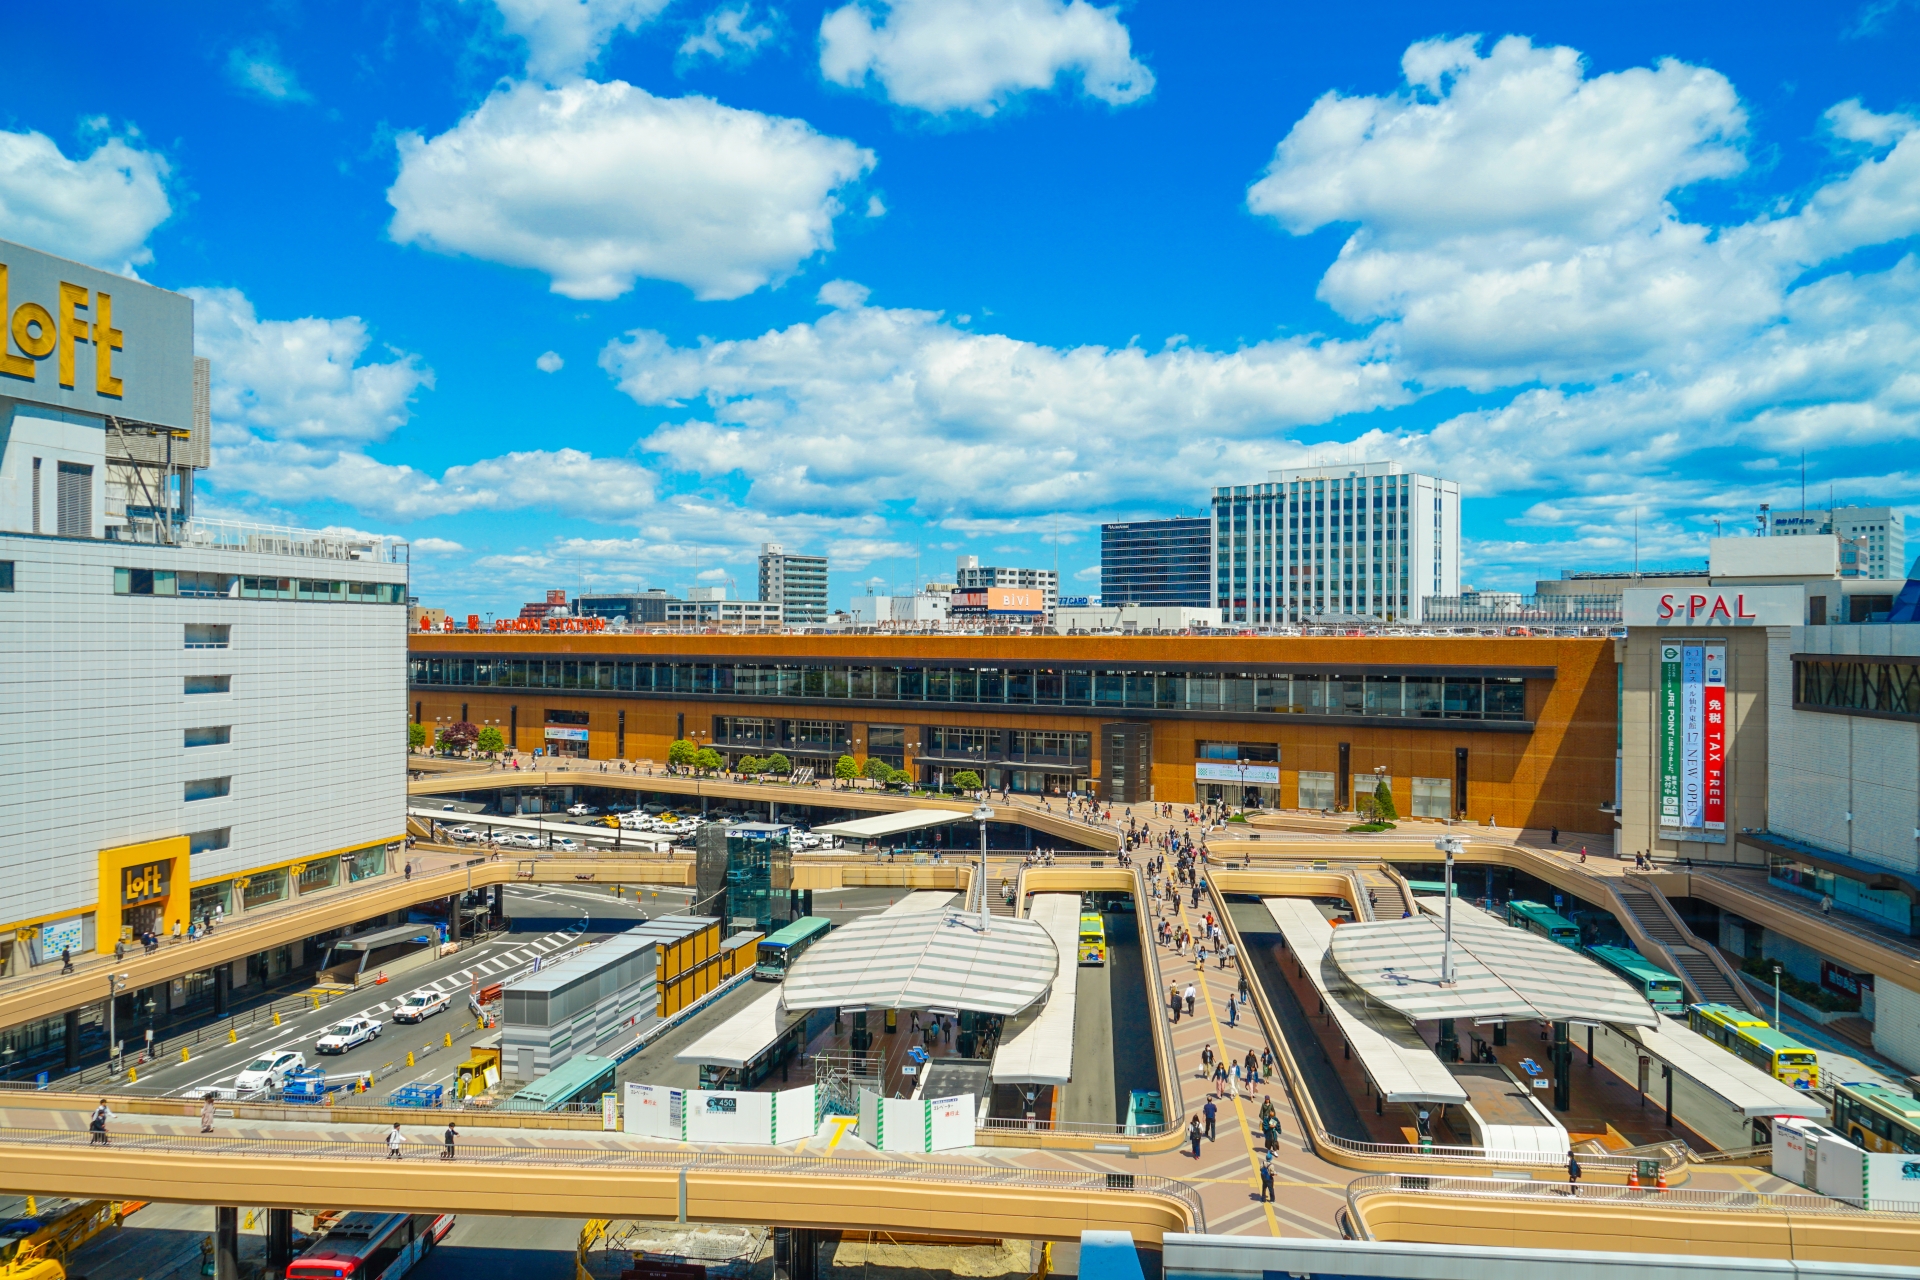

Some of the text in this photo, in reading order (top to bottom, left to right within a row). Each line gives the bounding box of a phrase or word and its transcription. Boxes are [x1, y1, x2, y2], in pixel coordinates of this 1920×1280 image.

[952, 593, 988, 606] GAME
[1660, 594, 1756, 619] S-PAL
[496, 618, 605, 631] SENDAI STATION
[1709, 700, 1721, 724] 免税
[1687, 732, 1698, 742] 17
[1709, 732, 1720, 805] TAX FREE
[1687, 749, 1698, 817] NEW OPEN
